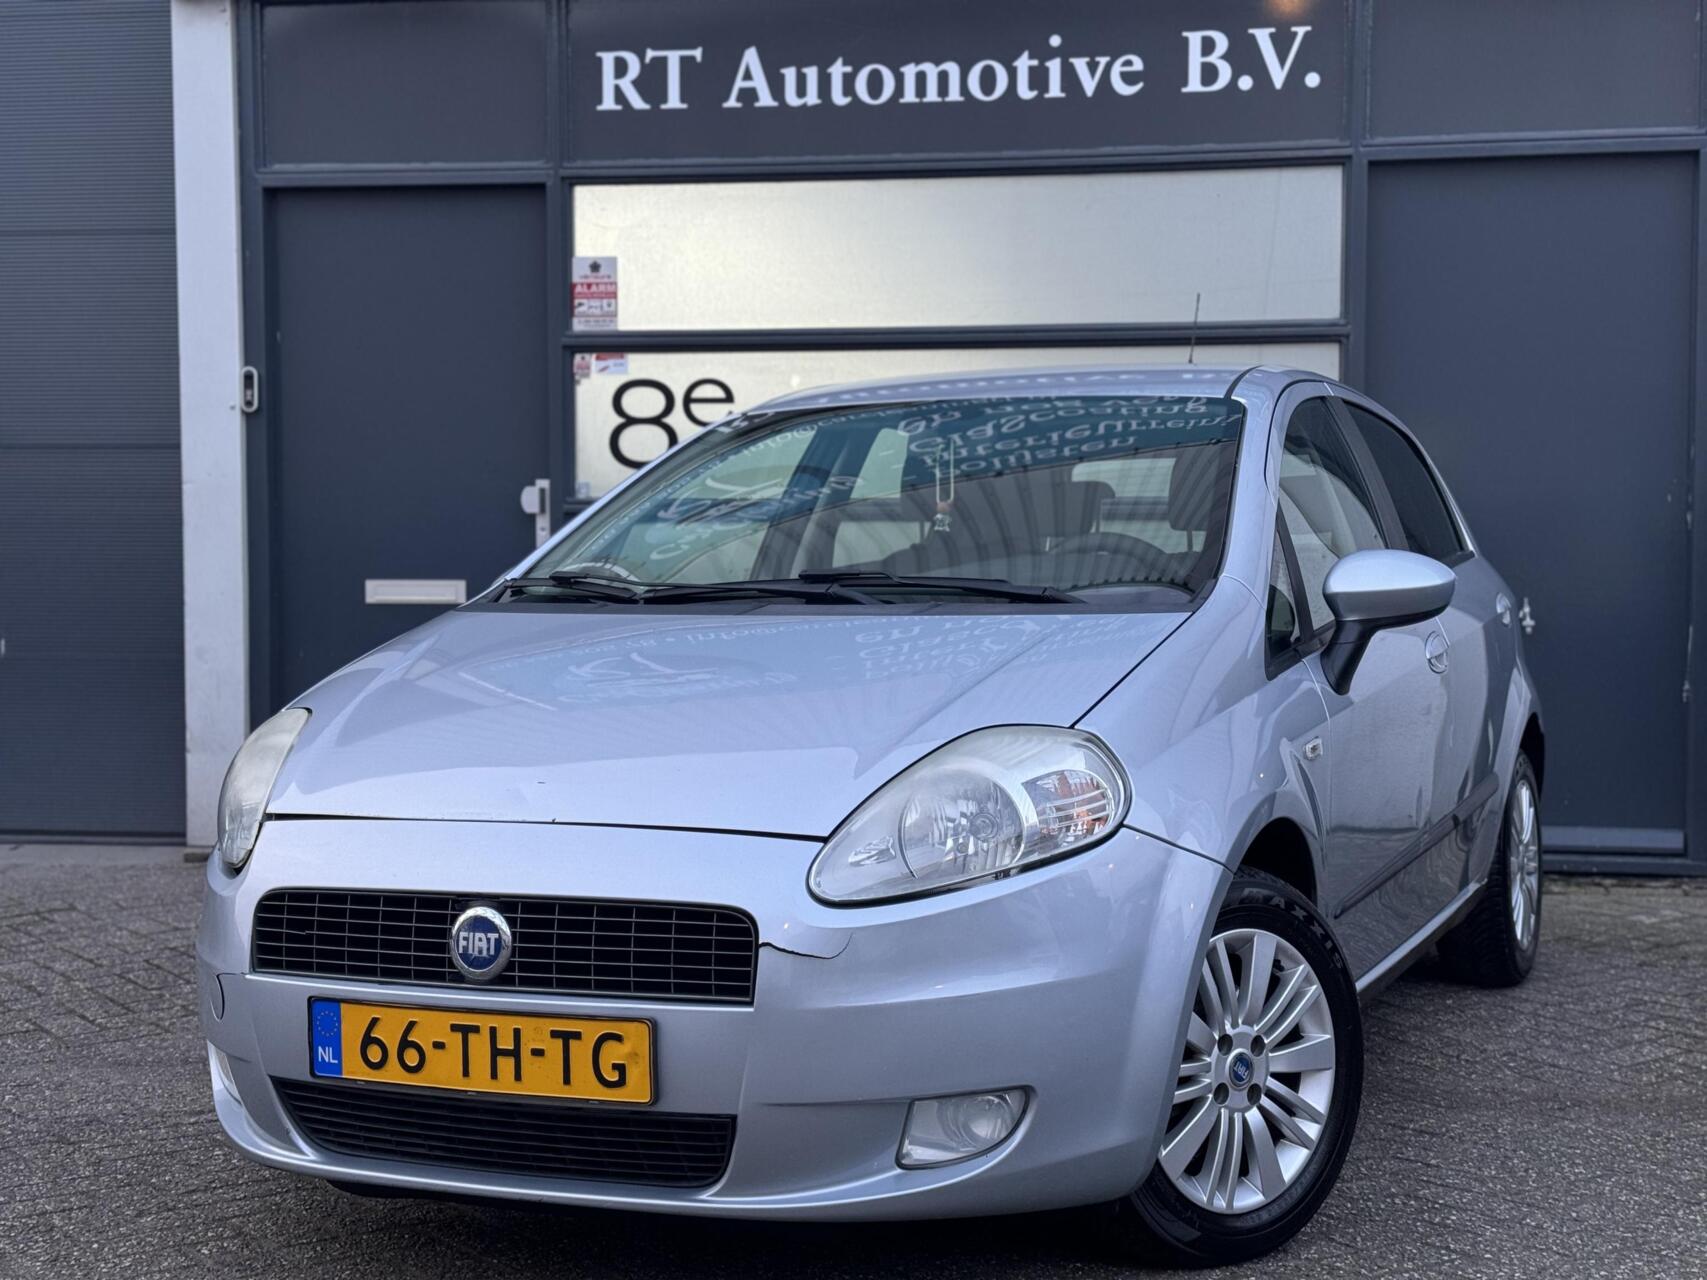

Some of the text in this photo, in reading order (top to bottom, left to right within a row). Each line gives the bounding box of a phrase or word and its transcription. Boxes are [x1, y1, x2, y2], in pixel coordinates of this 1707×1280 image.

[595, 26, 1321, 111] RT Automotive B.V.
[575, 283, 616, 292] ALARM
[458, 931, 500, 957] FIAT
[318, 1046, 338, 1064] NL
[360, 1016, 627, 1089] 66-TH-TG
